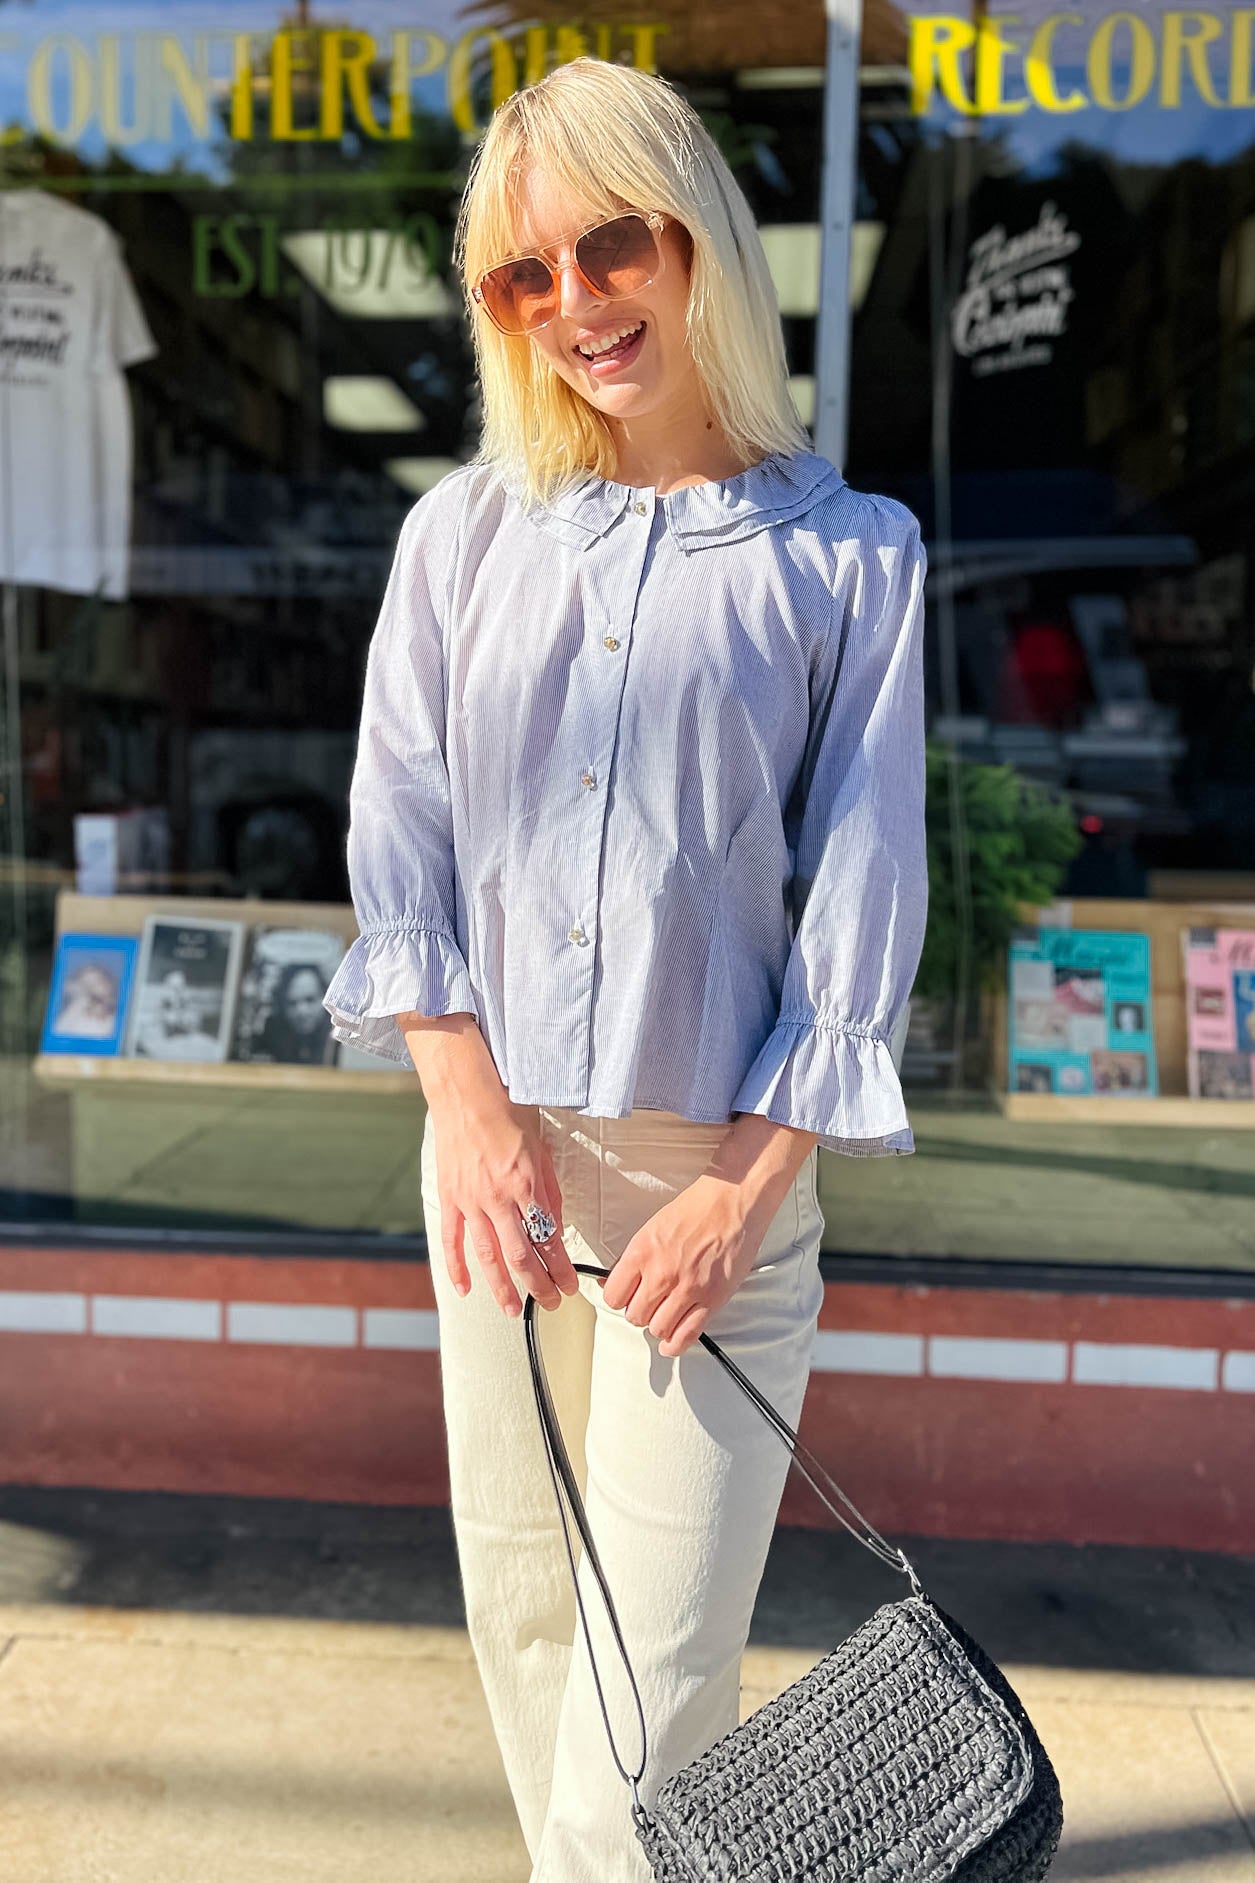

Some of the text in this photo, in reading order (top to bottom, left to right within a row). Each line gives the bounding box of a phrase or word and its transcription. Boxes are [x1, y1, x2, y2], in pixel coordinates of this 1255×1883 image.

[0, 23, 668, 146] OUNTERPOIT
[193, 212, 441, 298] EST. 1979
